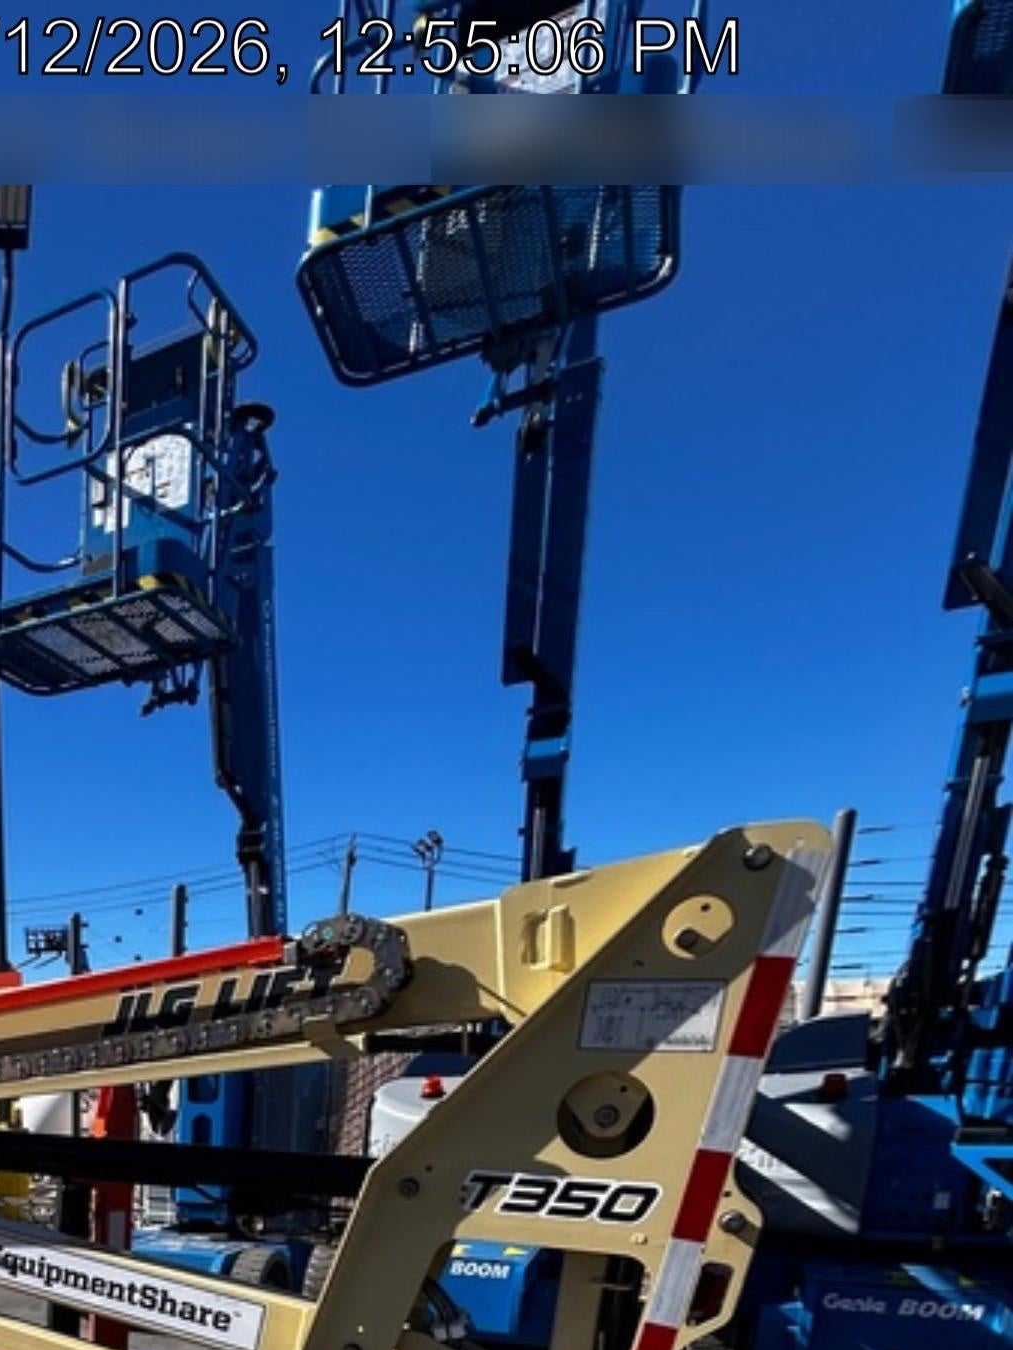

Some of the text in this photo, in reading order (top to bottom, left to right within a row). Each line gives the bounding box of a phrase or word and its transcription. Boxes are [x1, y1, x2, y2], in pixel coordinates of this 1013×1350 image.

[101, 982, 201, 1036] JLG
[462, 1170, 663, 1224] T350
[449, 1259, 511, 1281] BOOM
[896, 1298, 986, 1322] BOOM
